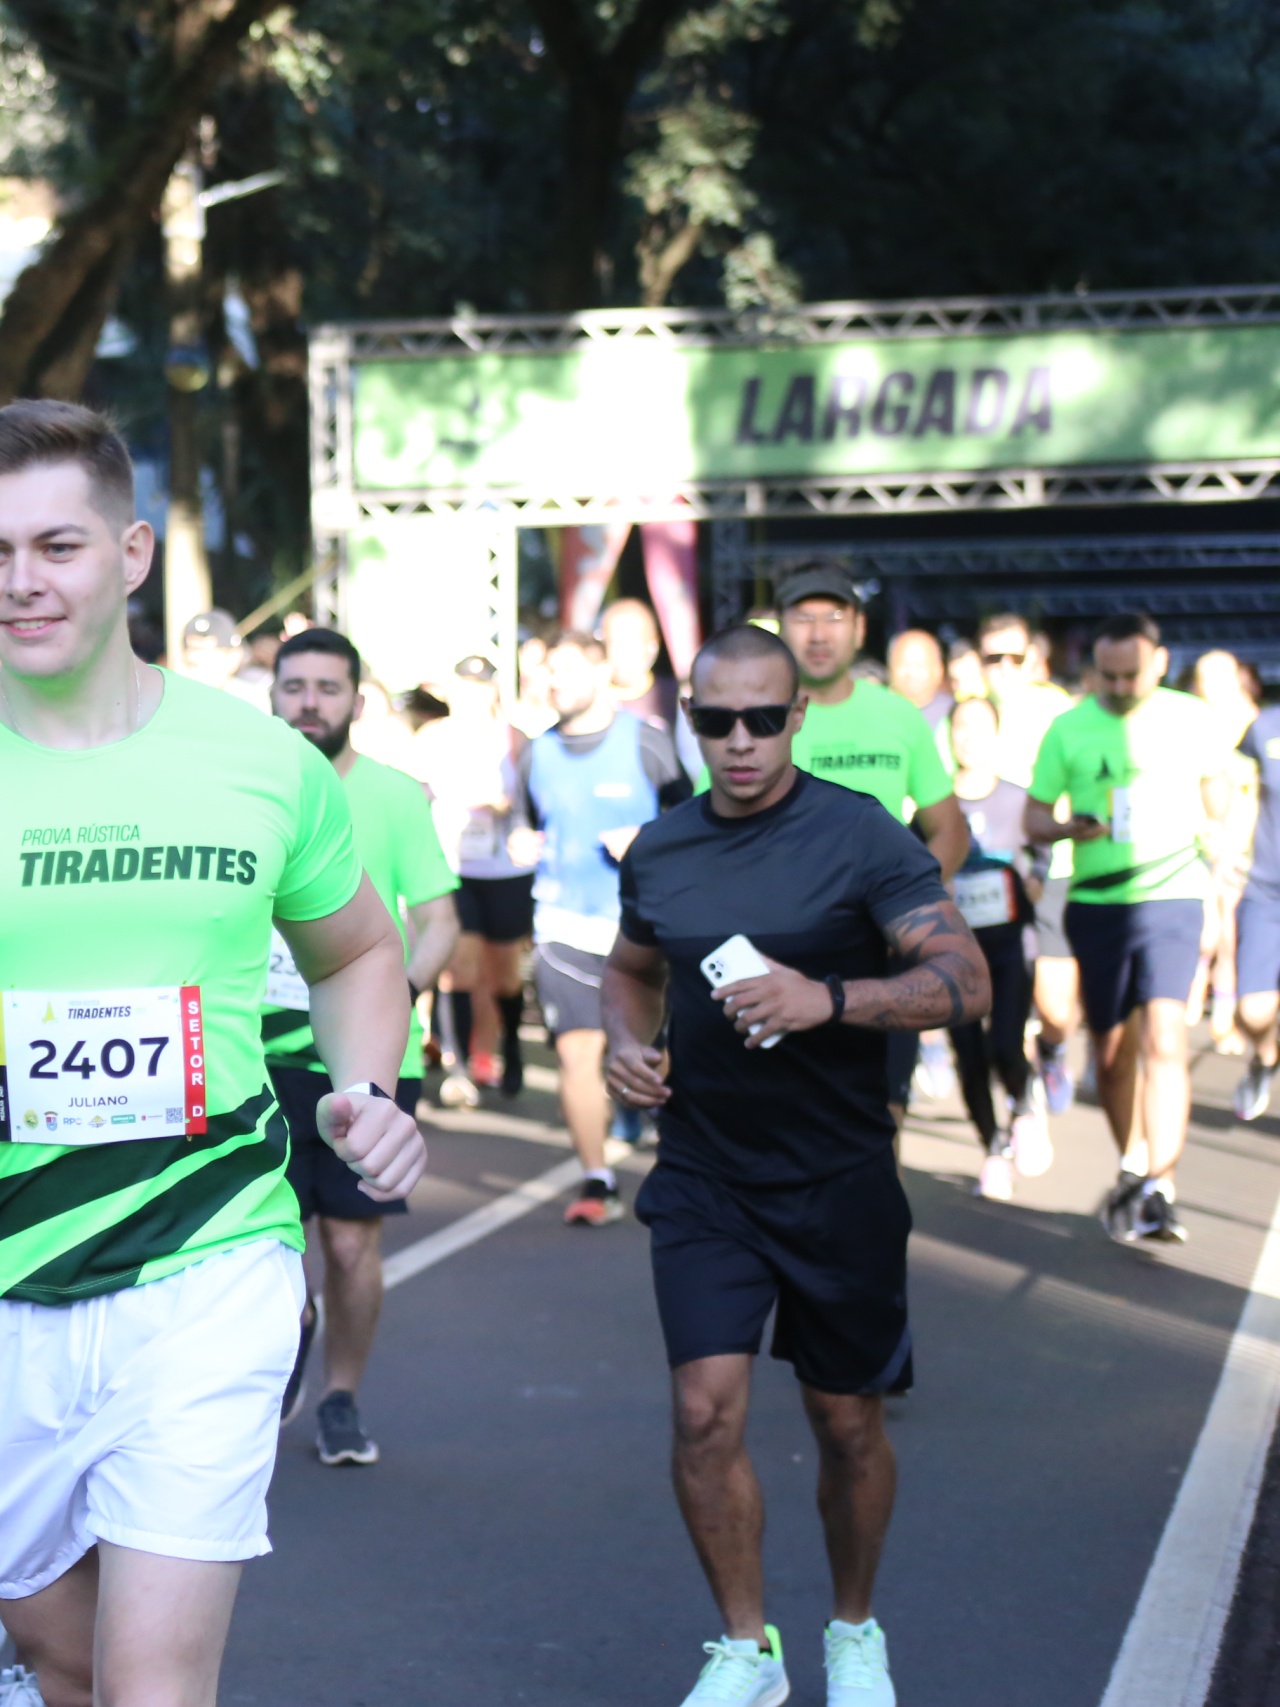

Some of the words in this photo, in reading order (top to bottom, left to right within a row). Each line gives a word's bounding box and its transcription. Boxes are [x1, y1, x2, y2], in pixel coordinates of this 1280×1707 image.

[735, 367, 1052, 444] LARGADA
[809, 754, 900, 771] TIRADENTES
[22, 827, 71, 847] PROVA
[77, 823, 140, 843] RÚSTICA
[20, 845, 257, 887] TIRADENTES
[68, 1006, 131, 1019] TIRADENTES
[187, 1001, 203, 1085] SETOR
[29, 1036, 169, 1079] 2407
[68, 1096, 128, 1107] JULIANO
[192, 1106, 203, 1116] D
